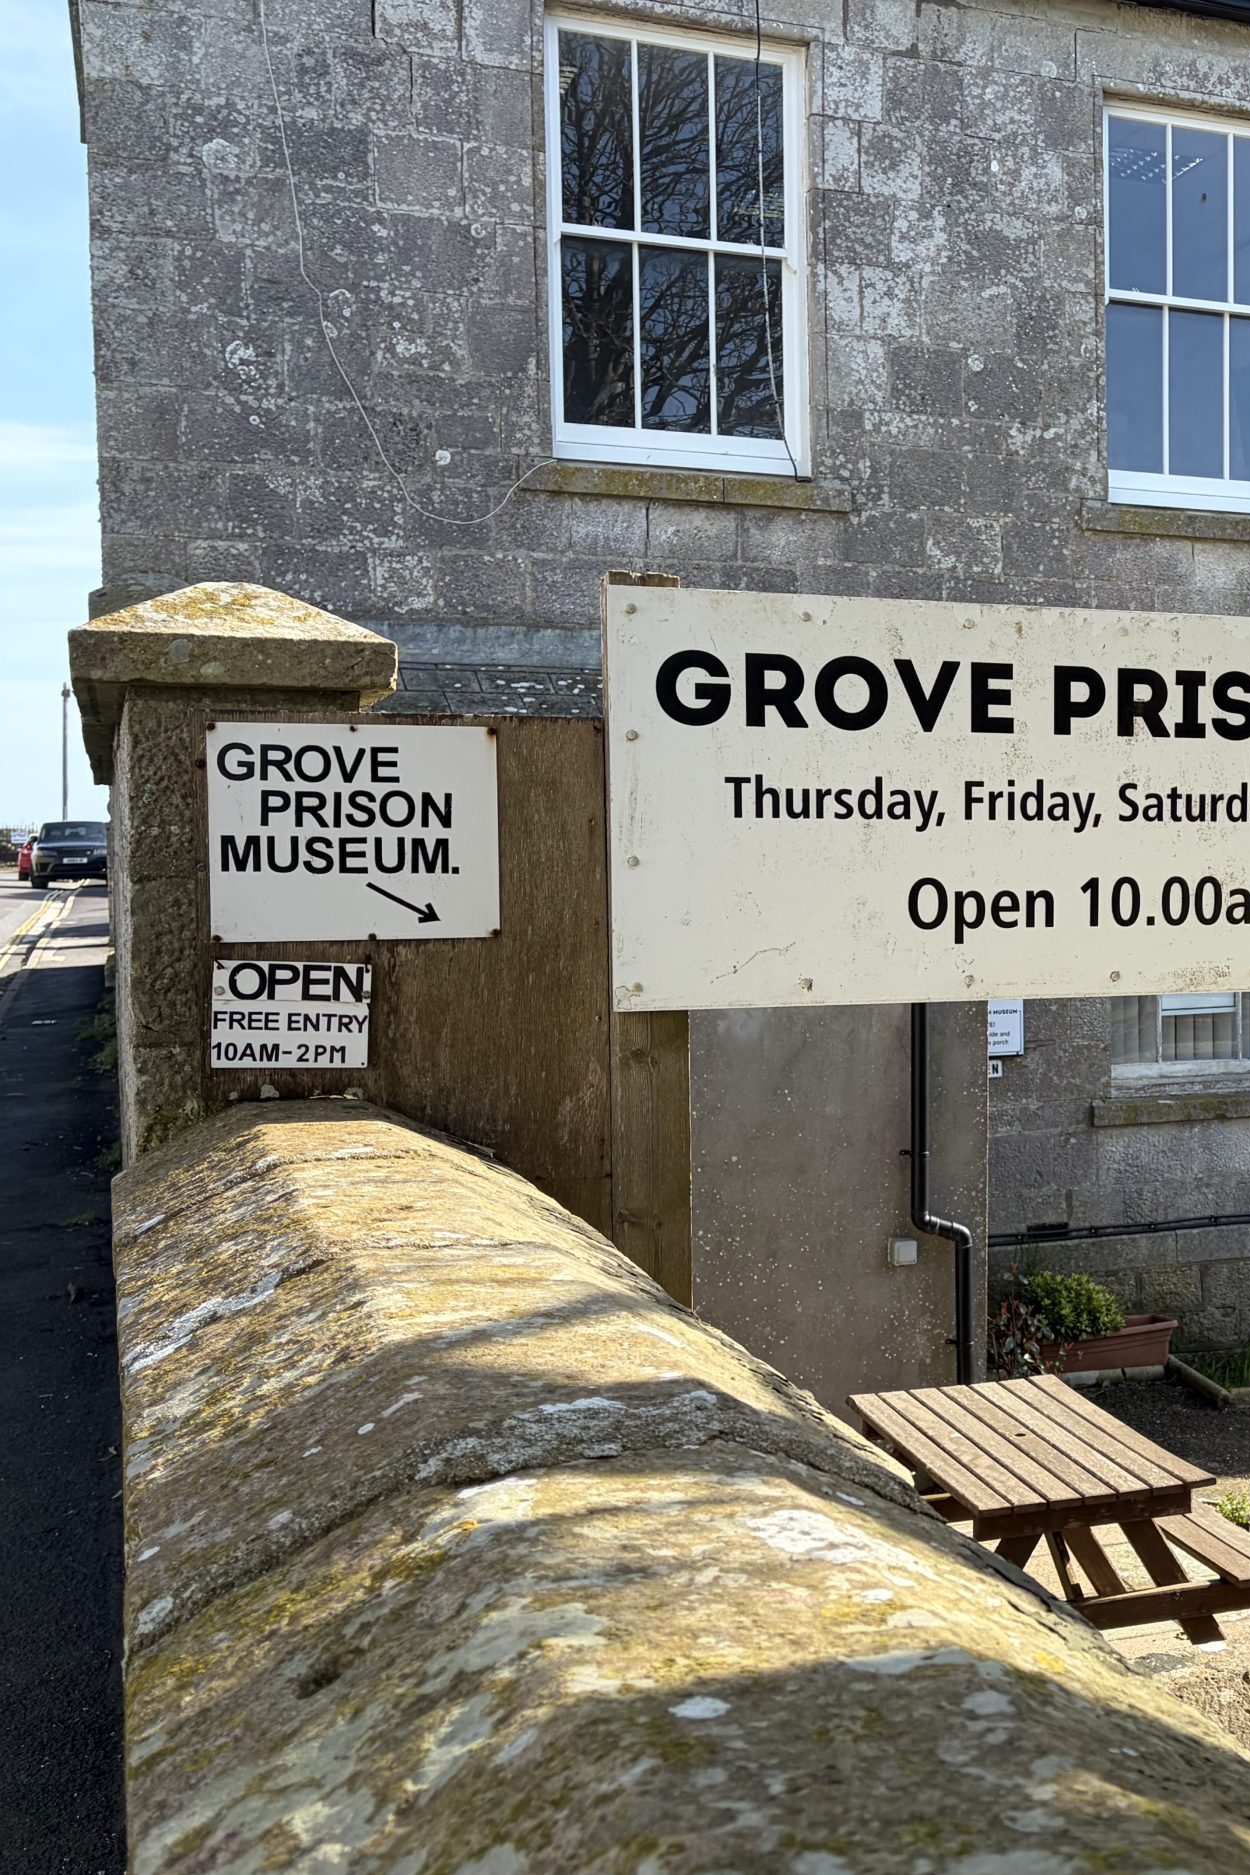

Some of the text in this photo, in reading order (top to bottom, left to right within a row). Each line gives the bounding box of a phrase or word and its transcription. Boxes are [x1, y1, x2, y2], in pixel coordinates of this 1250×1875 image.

[656, 650, 1014, 733] GROVE
[216, 743, 400, 783] GROVE
[260, 790, 452, 828] PRISON
[725, 775, 946, 831] Thursday,
[964, 780, 1101, 832] Friday,
[220, 835, 460, 874] MUSEUM.
[907, 877, 1055, 944] Open
[228, 962, 364, 1002] OPEN
[213, 1010, 368, 1033] FREE ENTRY
[988, 1063, 999, 1075] N
